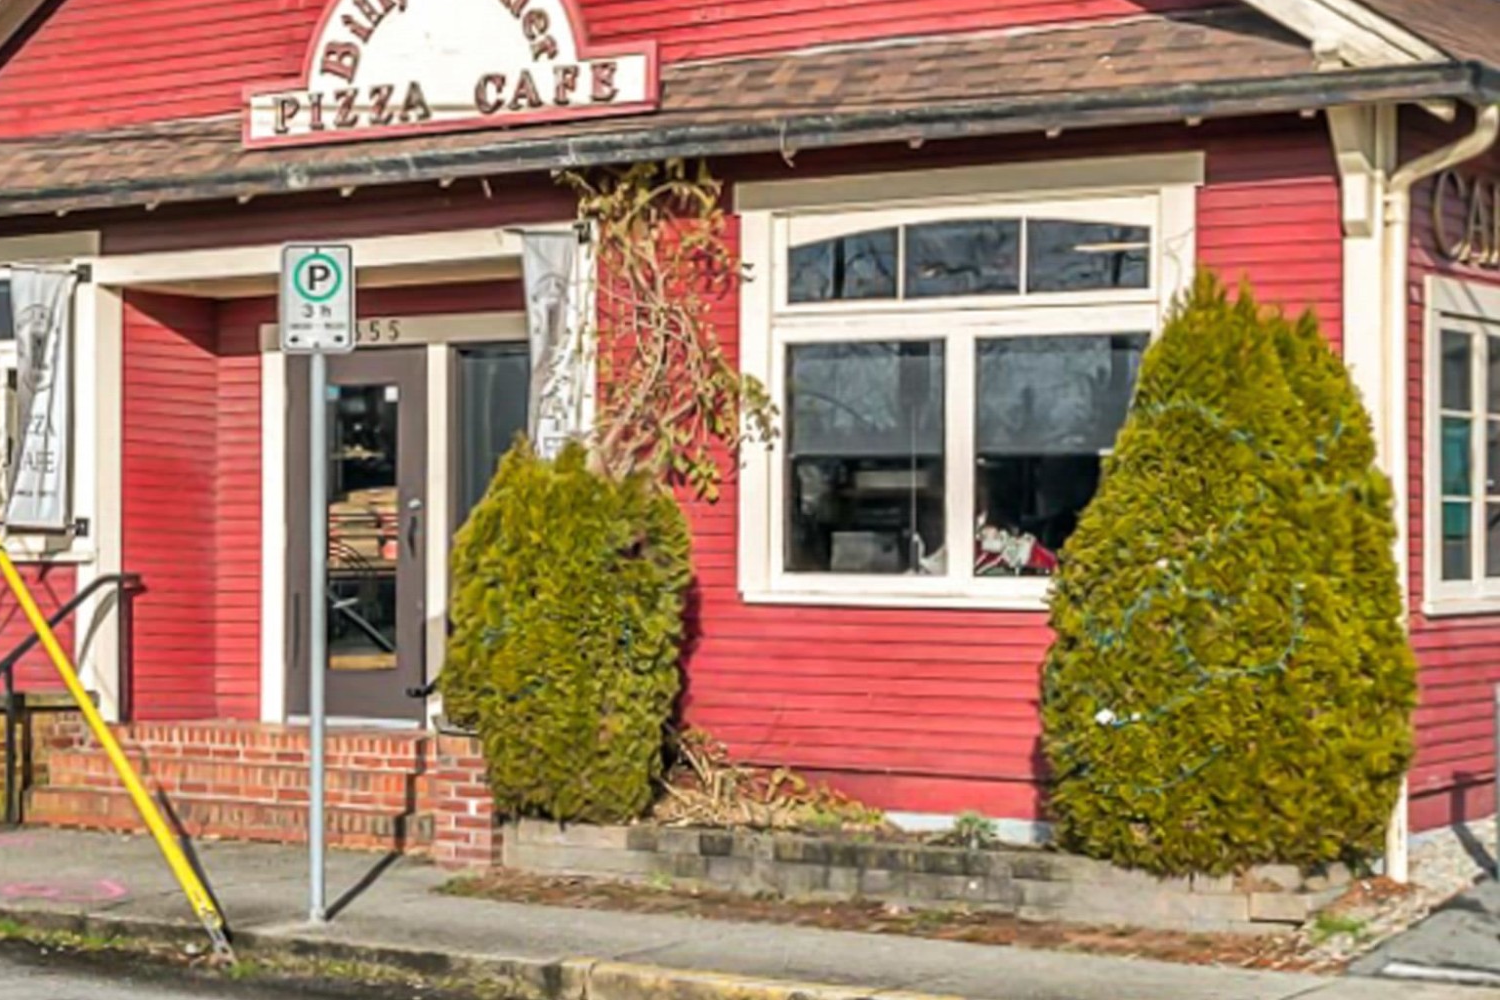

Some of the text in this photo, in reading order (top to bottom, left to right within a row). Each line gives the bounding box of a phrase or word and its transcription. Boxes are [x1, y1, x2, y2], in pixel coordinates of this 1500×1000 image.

[273, 61, 619, 134] PIZZA CAFE
[308, 265, 331, 291] P
